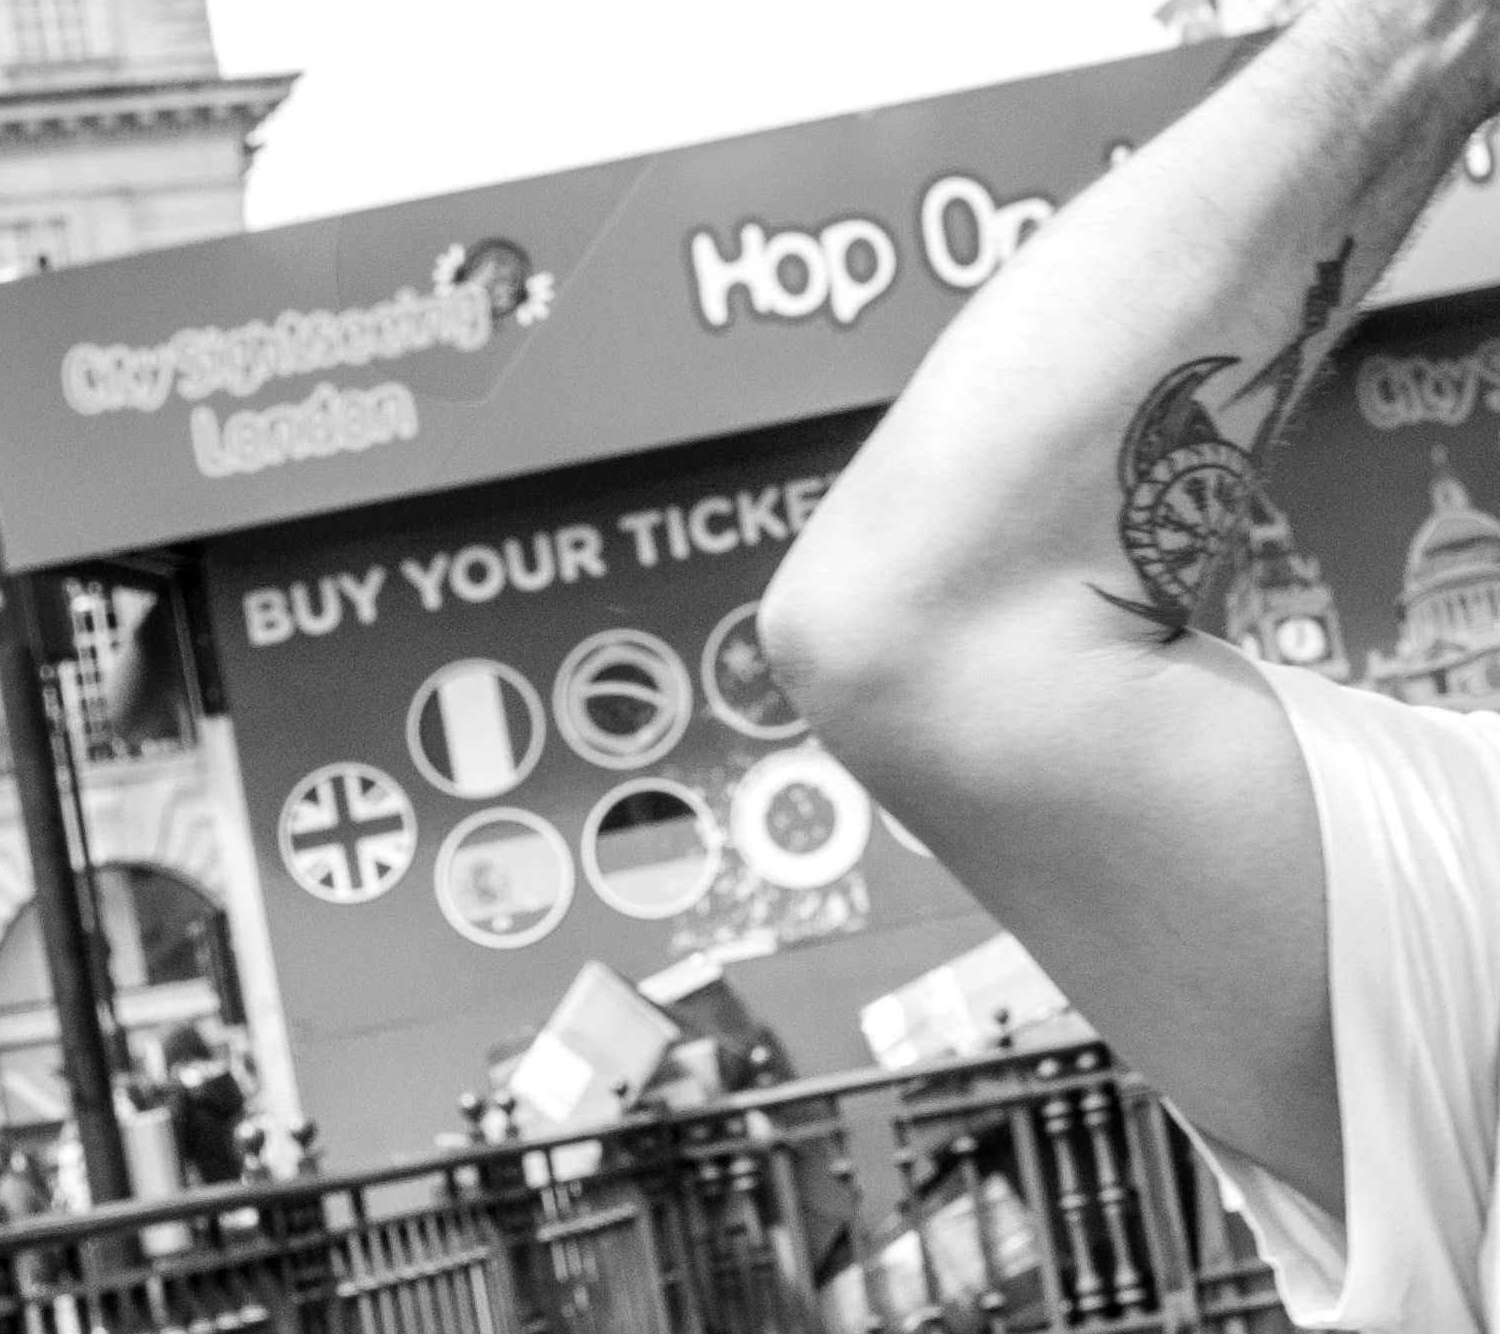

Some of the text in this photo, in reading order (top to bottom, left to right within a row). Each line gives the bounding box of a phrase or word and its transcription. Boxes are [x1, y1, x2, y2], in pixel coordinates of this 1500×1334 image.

[690, 217, 898, 329] Hop
[191, 380, 419, 478] London
[243, 471, 840, 648] BUY YOUR TICKE
